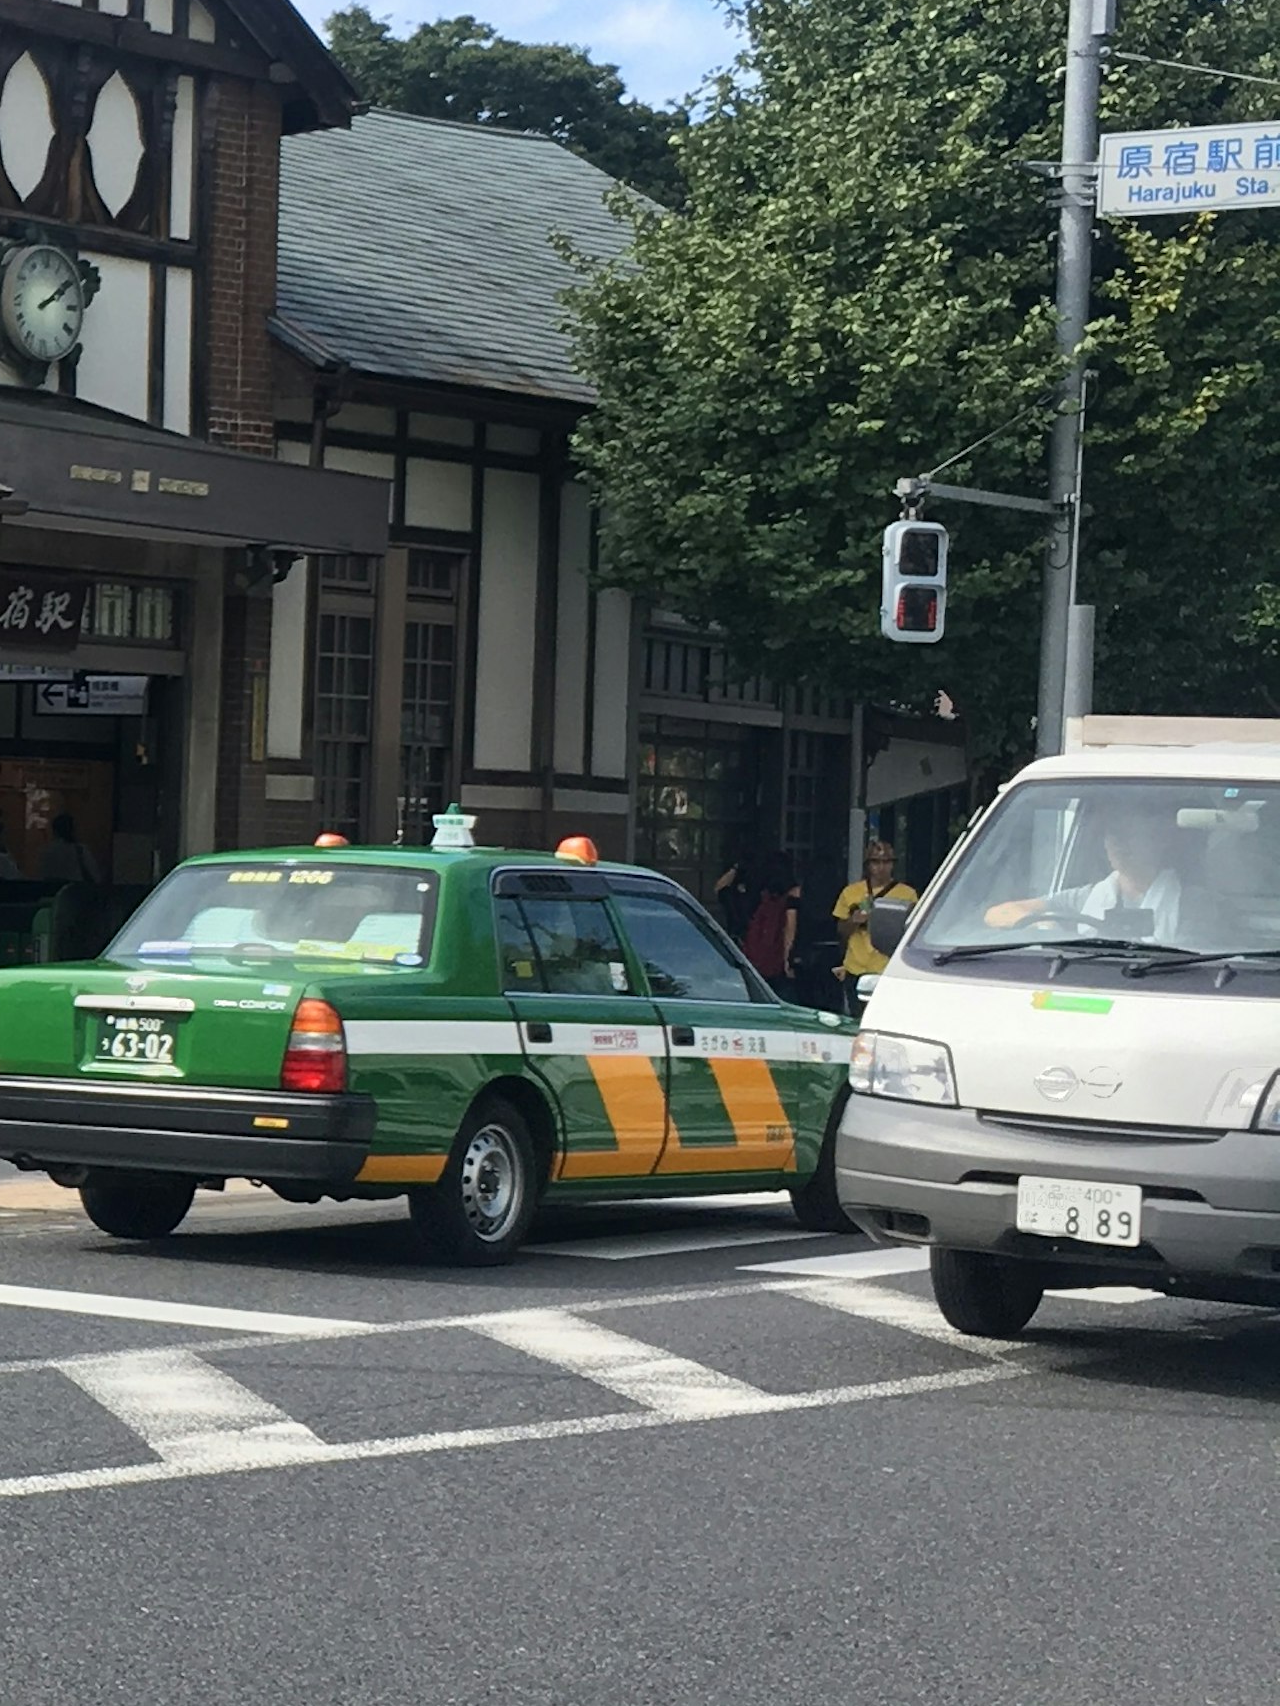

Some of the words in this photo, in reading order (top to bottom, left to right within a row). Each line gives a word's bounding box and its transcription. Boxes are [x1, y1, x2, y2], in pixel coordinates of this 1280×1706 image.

[1117, 135, 1280, 179] 原宿駅前
[1128, 181, 1216, 204] Harajuku
[1236, 177, 1276, 196] Sta.
[111, 1032, 173, 1060] 63-02
